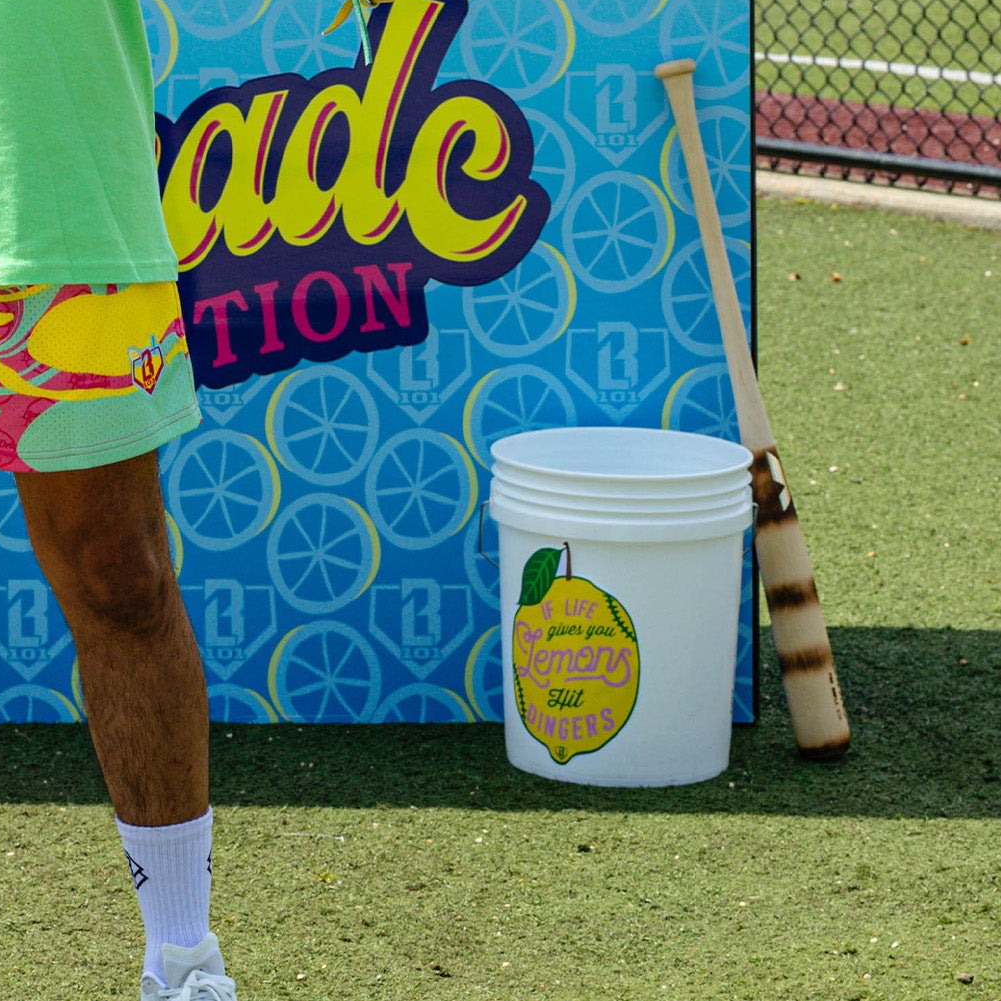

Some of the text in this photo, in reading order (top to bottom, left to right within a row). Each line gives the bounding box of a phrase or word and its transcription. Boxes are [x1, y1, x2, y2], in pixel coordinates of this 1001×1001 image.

[193, 262, 412, 368] TION
[541, 598, 598, 621] IF LIFE
[546, 624, 616, 642] gives you
[516, 621, 632, 688] Lemons
[547, 688, 585, 711] Hit
[527, 704, 615, 741] DINGERS
